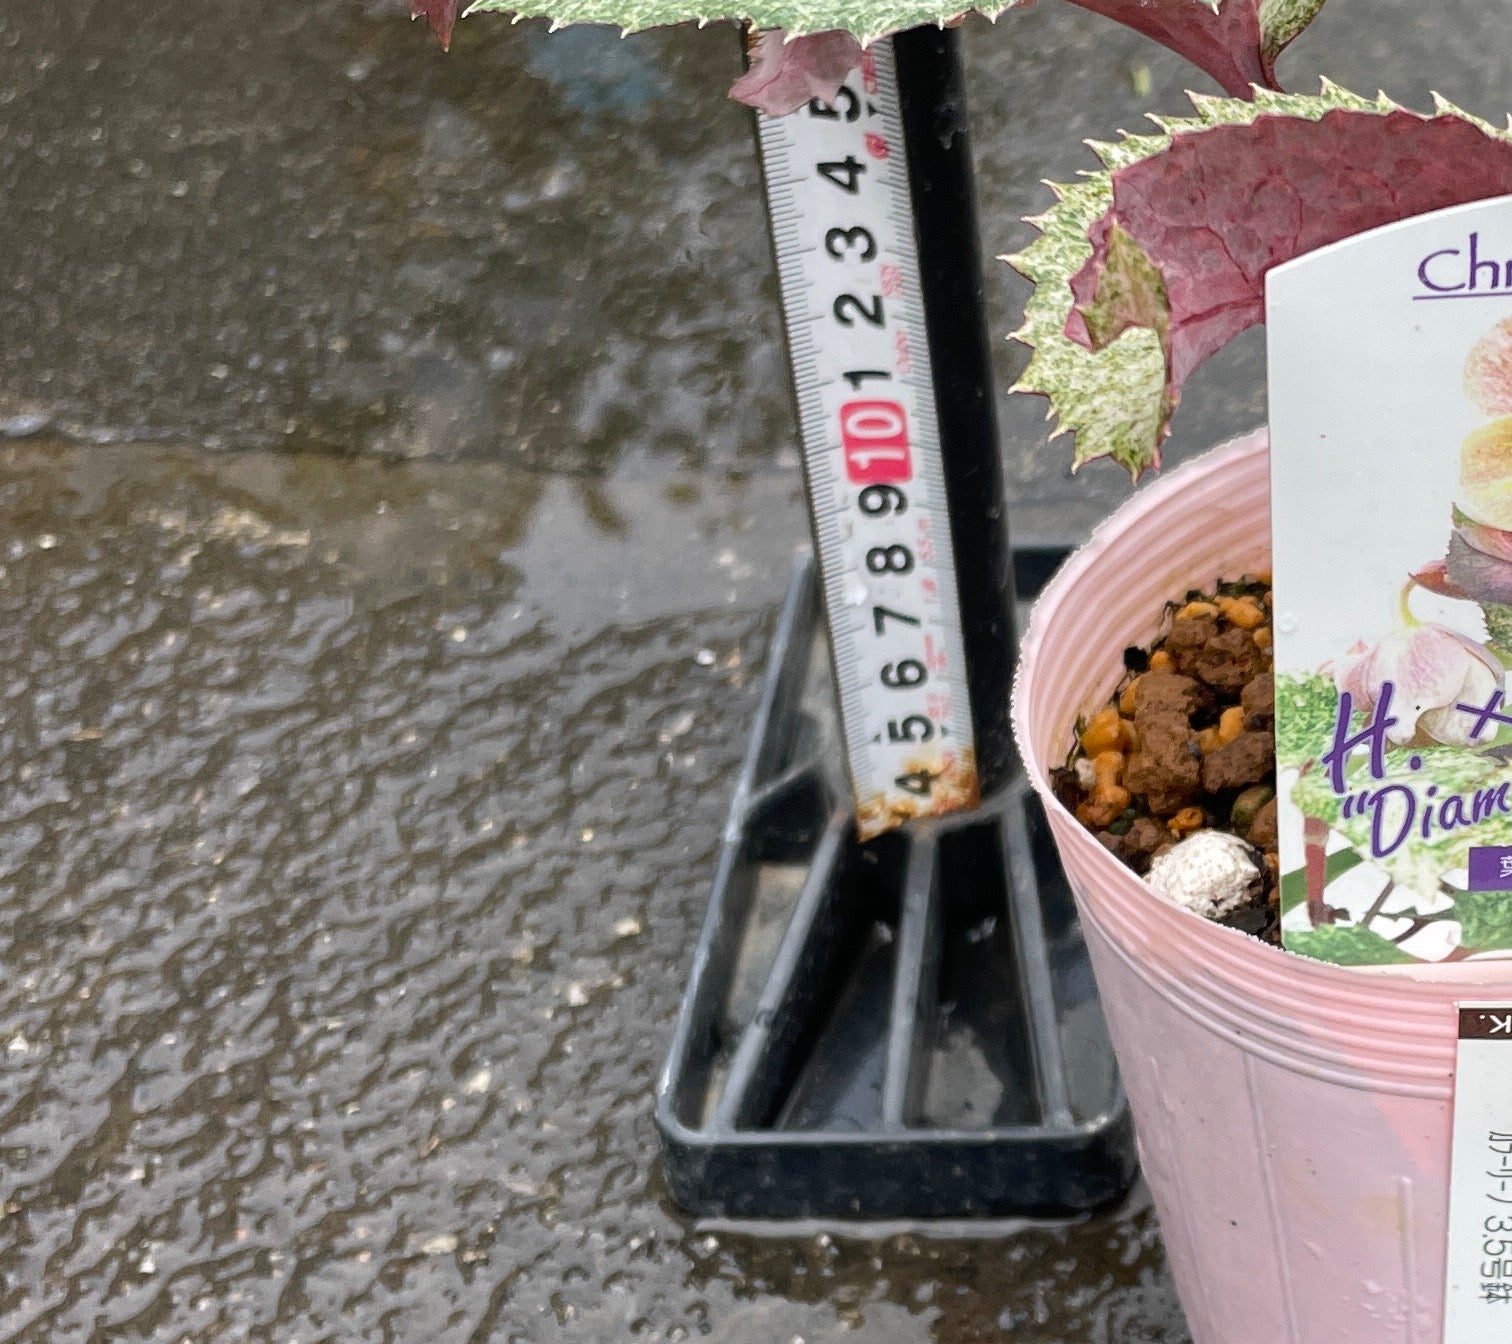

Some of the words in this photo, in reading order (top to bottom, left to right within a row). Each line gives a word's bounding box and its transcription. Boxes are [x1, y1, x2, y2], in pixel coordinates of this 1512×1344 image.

[816, 155, 867, 196] 4
[825, 226, 877, 263] 3
[833, 293, 886, 329] 2
[842, 370, 891, 391] 1
[846, 409, 906, 471] 10
[858, 484, 908, 518] 9
[866, 545, 916, 576] 8
[873, 605, 921, 637] 7
[880, 658, 928, 690] 6
[887, 714, 935, 743] 5
[1322, 681, 1424, 797] H.
[895, 768, 932, 797] 4
